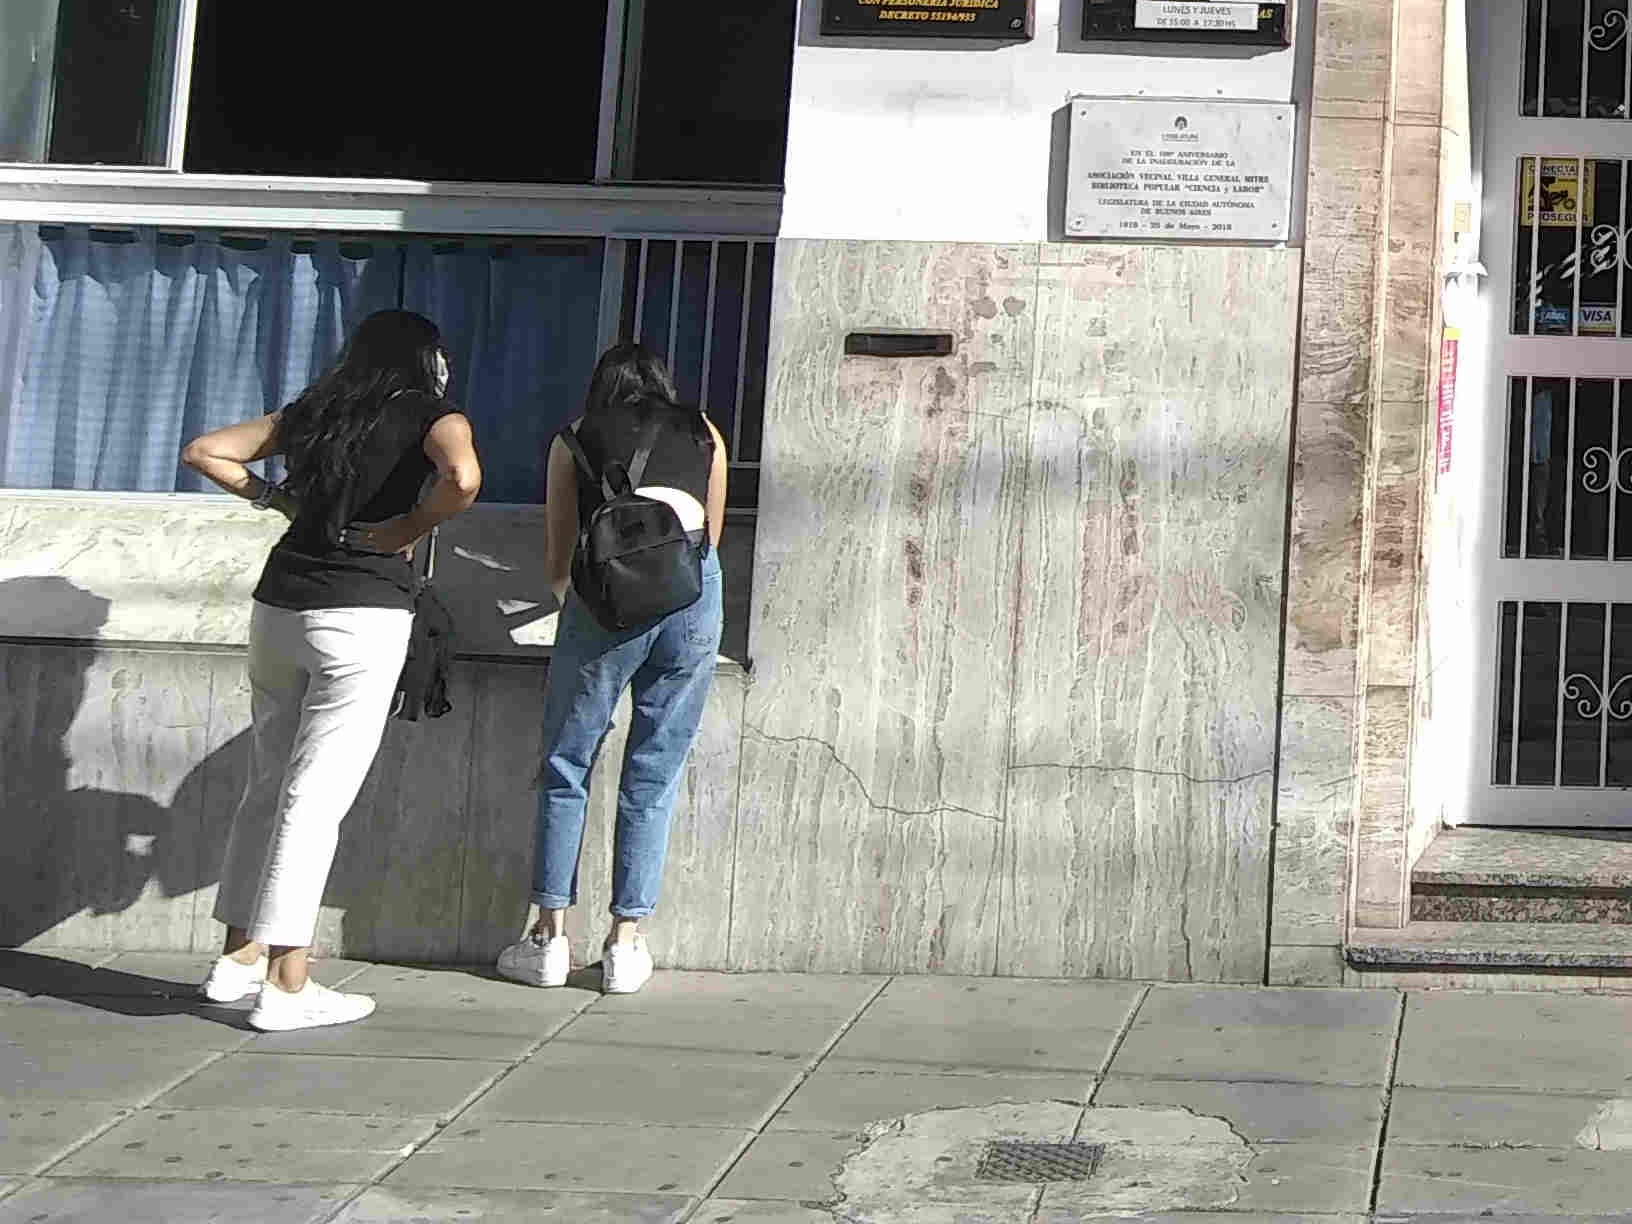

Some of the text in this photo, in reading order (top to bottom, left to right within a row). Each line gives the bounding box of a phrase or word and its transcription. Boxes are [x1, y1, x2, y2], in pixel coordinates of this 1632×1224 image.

[949, 0, 999, 9] JURIDICA
[879, 10, 928, 21] DECRETO
[1162, 5, 1191, 15] LUNES
[1200, 7, 1232, 16] JUEVES
[1203, 174, 1241, 183] GENERAL
[1143, 182, 1180, 192] POPULAR
[1584, 311, 1612, 322] VISA
